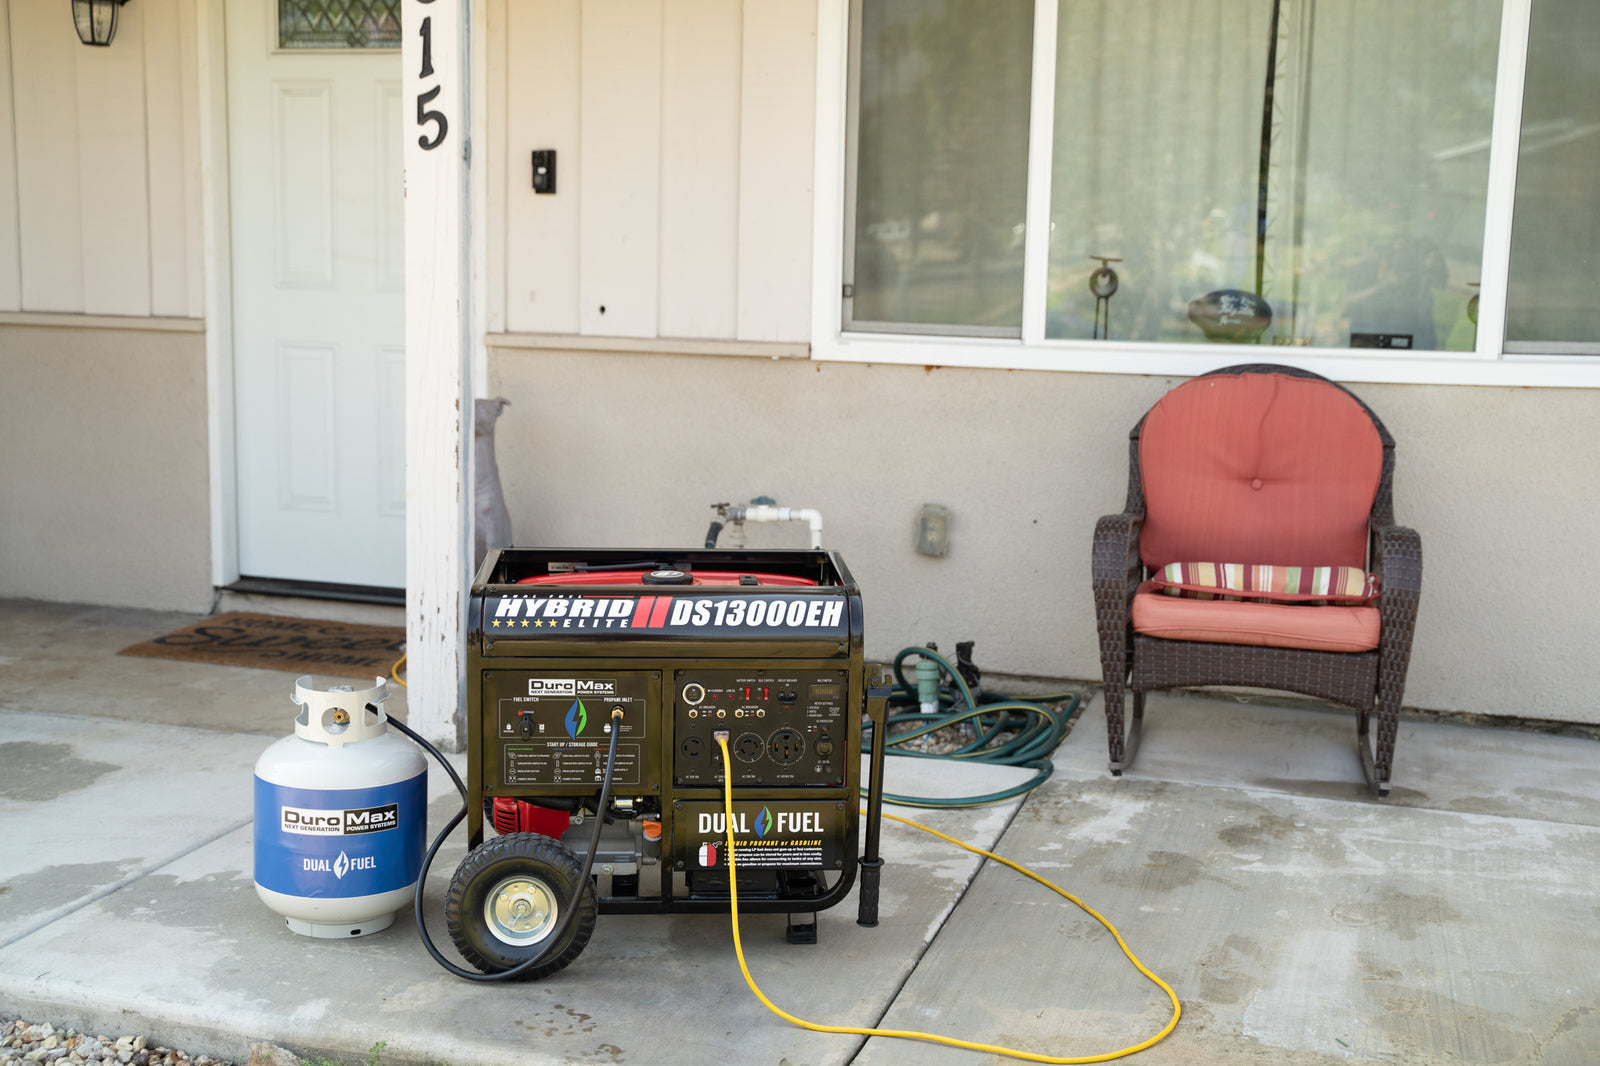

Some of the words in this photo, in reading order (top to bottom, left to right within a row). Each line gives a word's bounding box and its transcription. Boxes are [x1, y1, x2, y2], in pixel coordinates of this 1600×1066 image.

[416, 0, 448, 150] 15
[495, 599, 634, 617] HYBRID
[670, 600, 844, 627] DS13000EH
[563, 619, 628, 628] ELITE
[370, 820, 396, 829] SYSTEMS
[777, 812, 824, 832] FUEL
[304, 859, 331, 871] DUAL
[351, 856, 376, 870] FUEL
